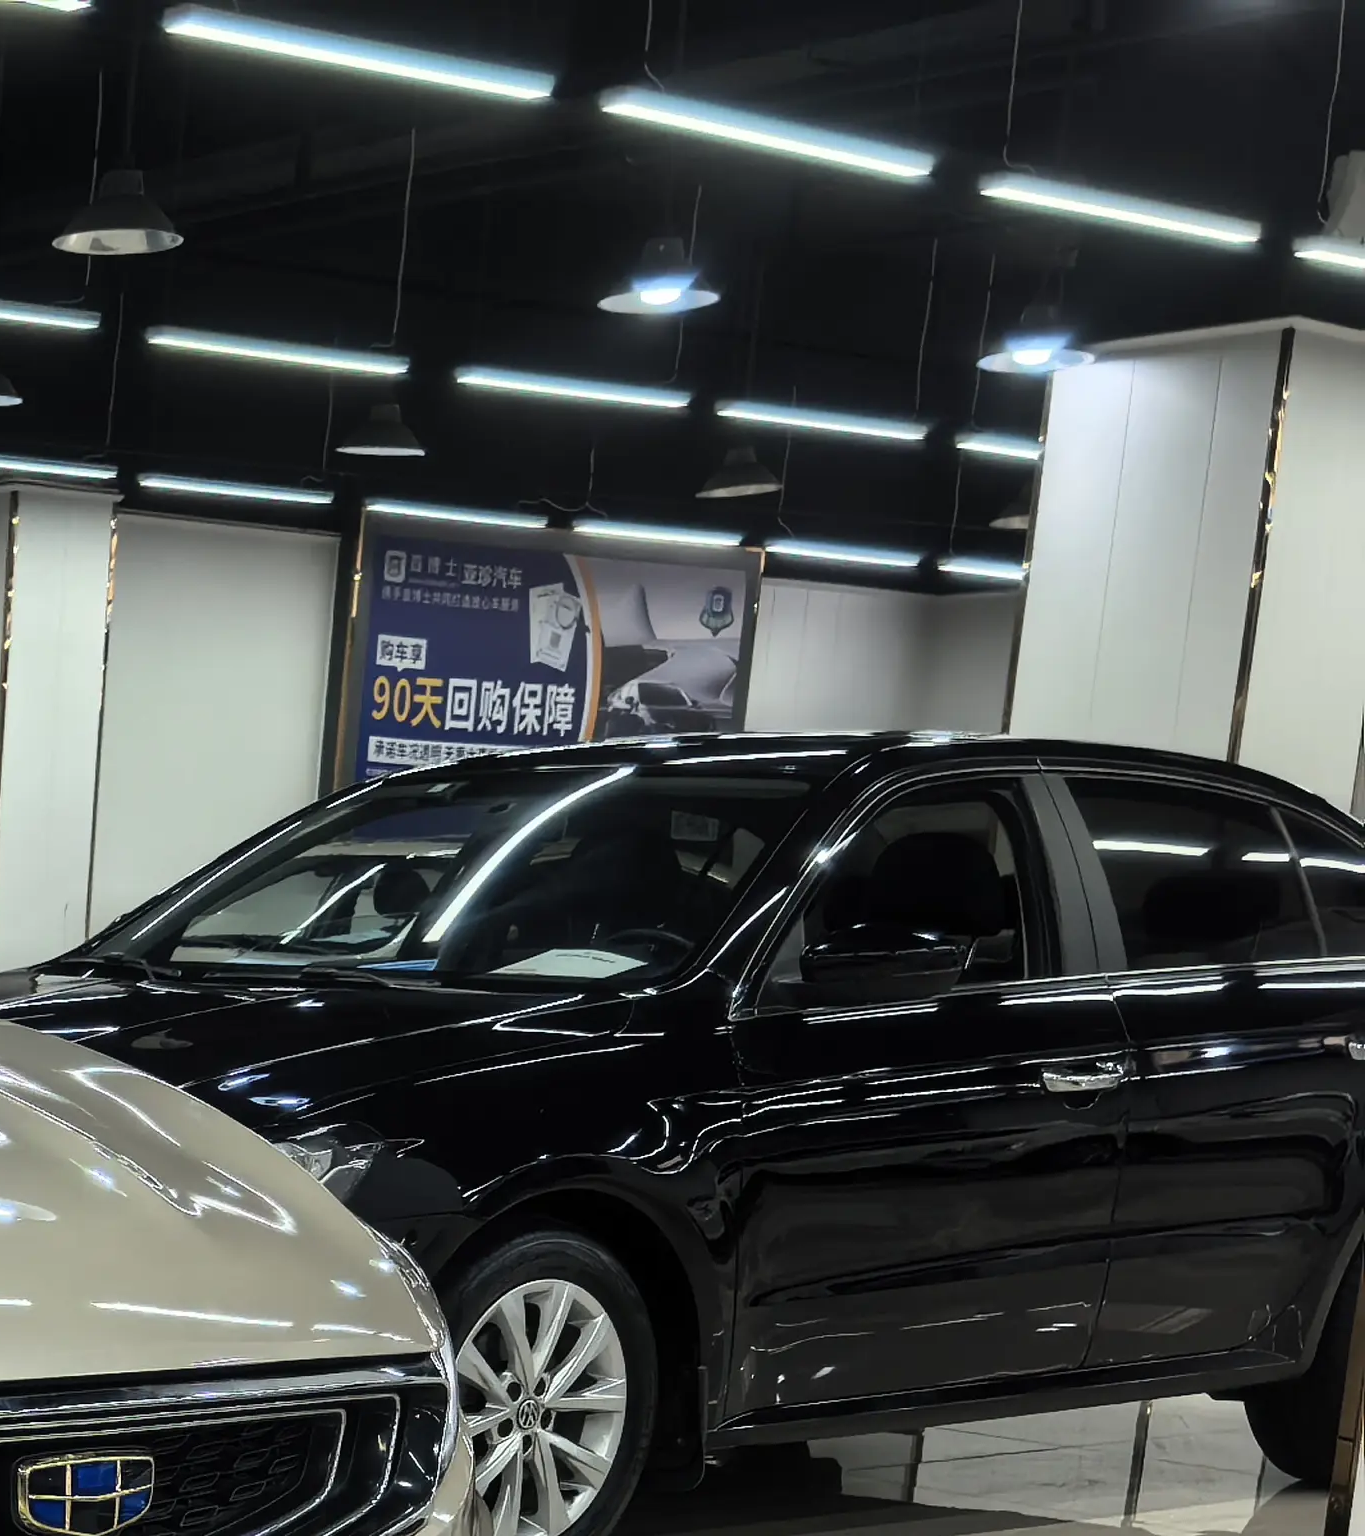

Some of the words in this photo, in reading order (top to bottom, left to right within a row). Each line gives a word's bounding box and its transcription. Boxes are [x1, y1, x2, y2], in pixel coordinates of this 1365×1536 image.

[461, 562, 523, 590] 亚珍汽车
[379, 640, 424, 665] 购车享
[371, 675, 577, 737] 90天回购保障
